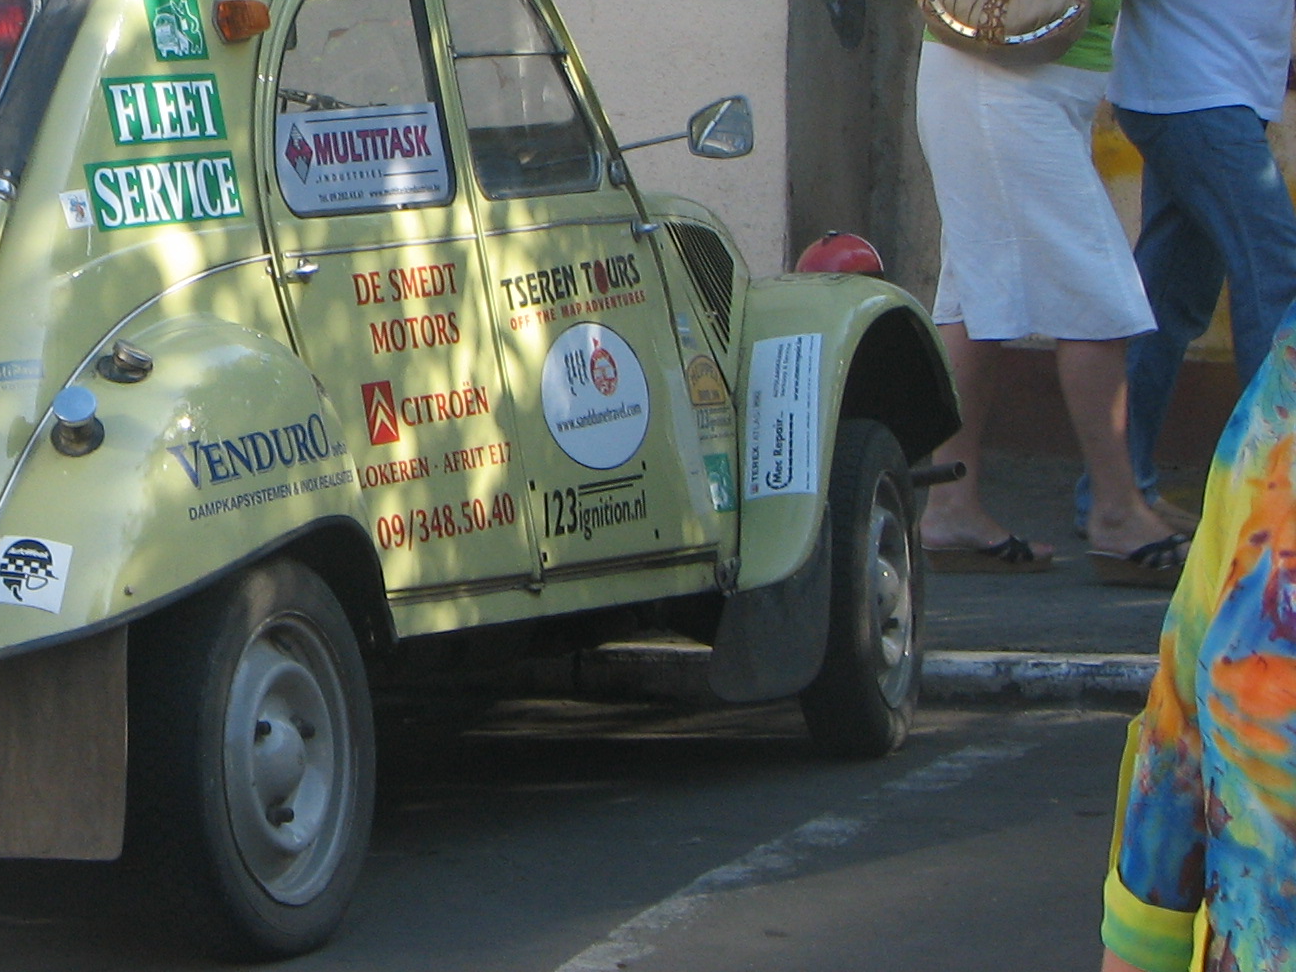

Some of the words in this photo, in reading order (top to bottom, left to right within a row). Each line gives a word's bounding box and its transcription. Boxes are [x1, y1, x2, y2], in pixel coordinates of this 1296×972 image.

[108, 79, 218, 142] FLEET
[312, 125, 432, 166] MULTITASK
[93, 157, 241, 227] SERVICE
[352, 271, 385, 306] DE
[388, 263, 457, 302] SMEDT
[500, 264, 579, 311] TSEREN
[580, 253, 641, 295] TOURS
[510, 314, 530, 331] OFF
[536, 308, 557, 325] THE
[560, 302, 583, 319] MAP
[585, 290, 646, 314] ADVENTURES
[369, 312, 460, 354] MOTORS
[401, 381, 490, 427] CITROËN
[166, 413, 331, 490] VENDURO
[772, 418, 787, 457] Repair
[357, 457, 431, 489] LOKEREN
[444, 446, 485, 474] AFRIT
[188, 483, 293, 521] DAMPKAPSYSTEMEN
[377, 492, 516, 551] 09/348.50.40
